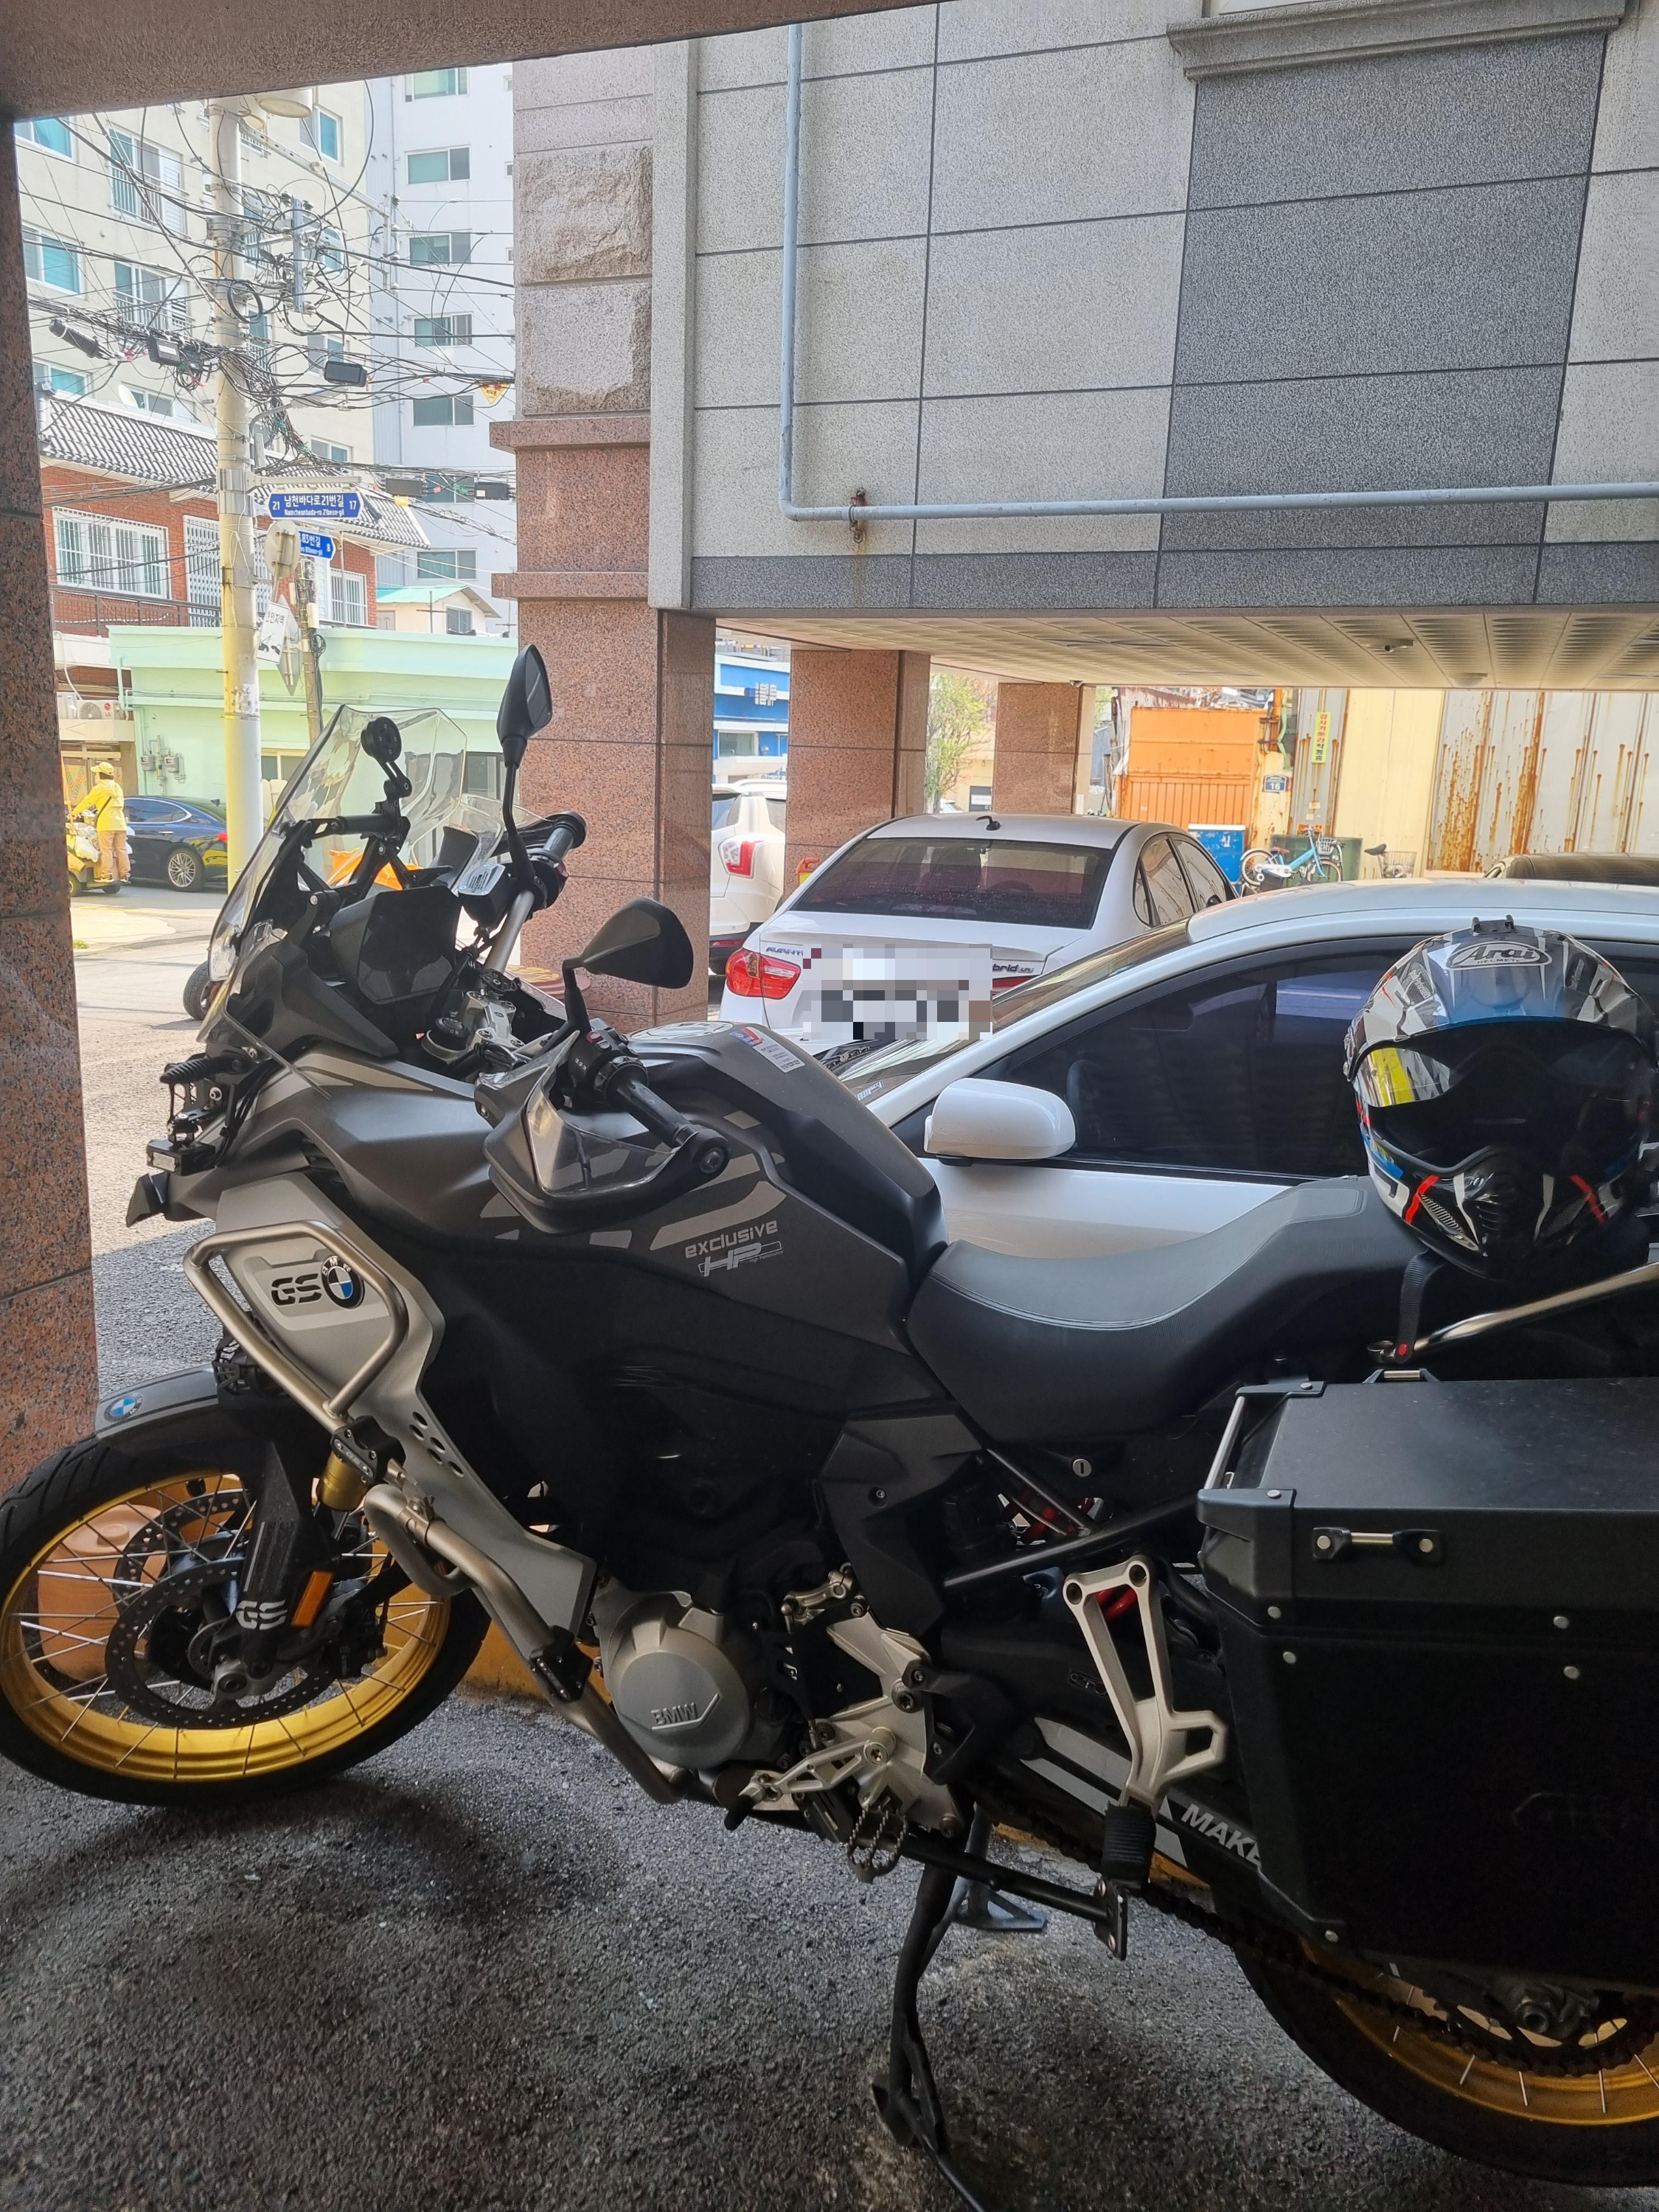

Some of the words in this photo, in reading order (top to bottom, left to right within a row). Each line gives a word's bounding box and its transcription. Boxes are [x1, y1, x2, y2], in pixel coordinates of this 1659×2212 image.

[272, 501, 280, 510] 21
[284, 495, 344, 508] 남천바다로21번길
[349, 500, 357, 510] 17
[327, 543, 331, 552] 8
[1270, 782, 1281, 790] 16
[1460, 946, 1538, 962] Arai
[684, 1220, 779, 1259] exclusive
[703, 1242, 763, 1277] HP
[271, 1273, 322, 1306] GS
[235, 1599, 288, 1630] GS
[650, 1702, 699, 1725] BMW
